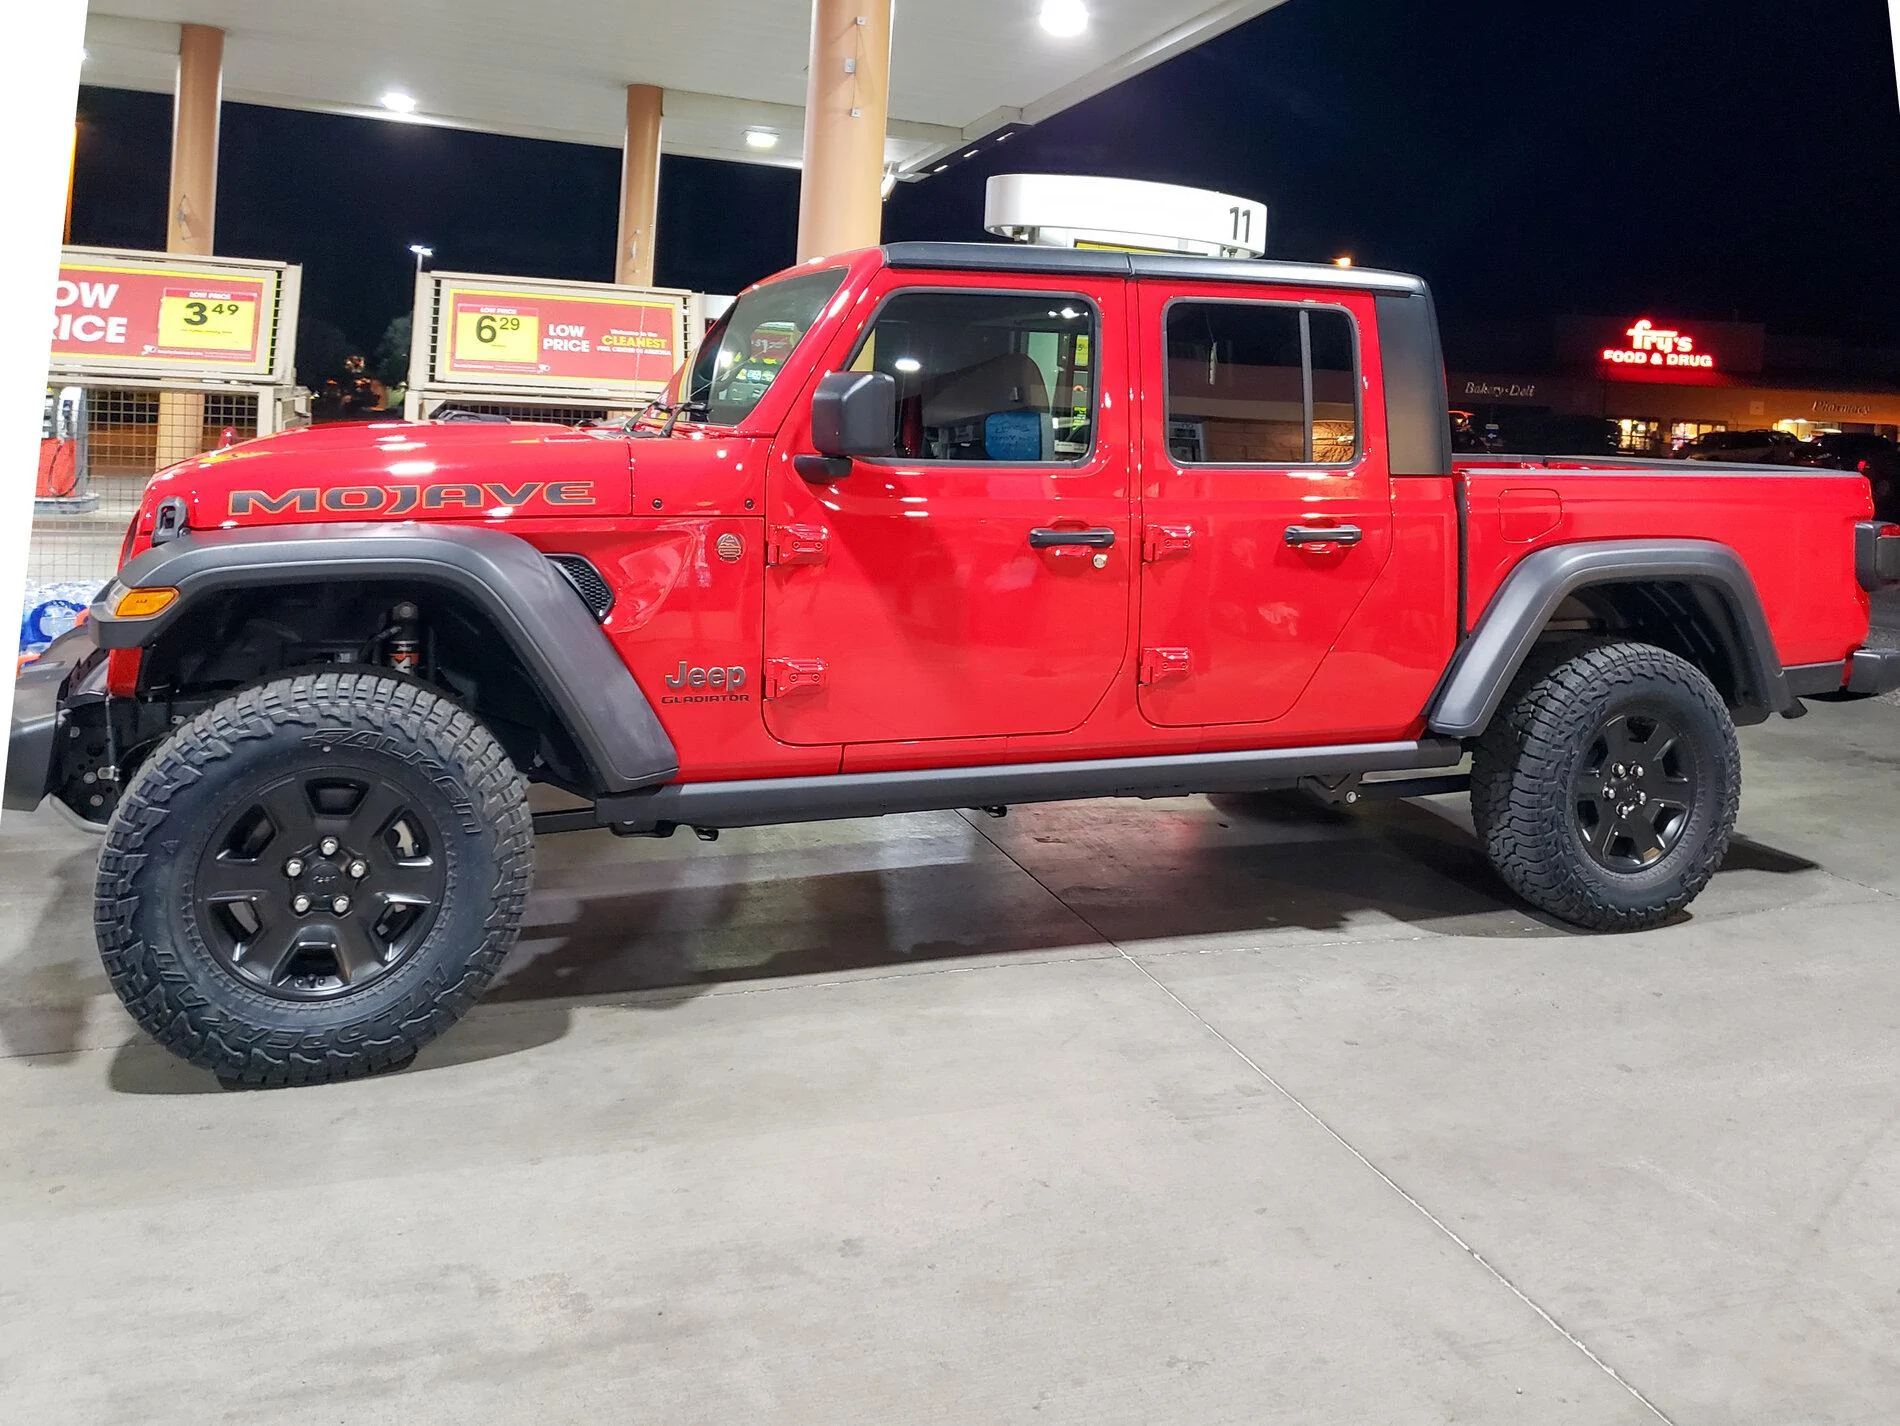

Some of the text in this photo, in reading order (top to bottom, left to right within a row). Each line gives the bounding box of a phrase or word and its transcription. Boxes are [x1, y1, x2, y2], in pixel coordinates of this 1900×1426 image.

[1229, 206, 1250, 243] 11
[548, 323, 586, 338] LOW
[601, 334, 668, 349] CLEANEST
[1626, 319, 1693, 354] fry's
[542, 337, 590, 353] PRICE
[1603, 349, 1713, 368] FOOD & DRUG
[228, 481, 597, 517] MOJAVE
[664, 660, 747, 695] Jeep
[661, 693, 750, 705] GLADIATOR
[301, 727, 483, 835] FALKEN
